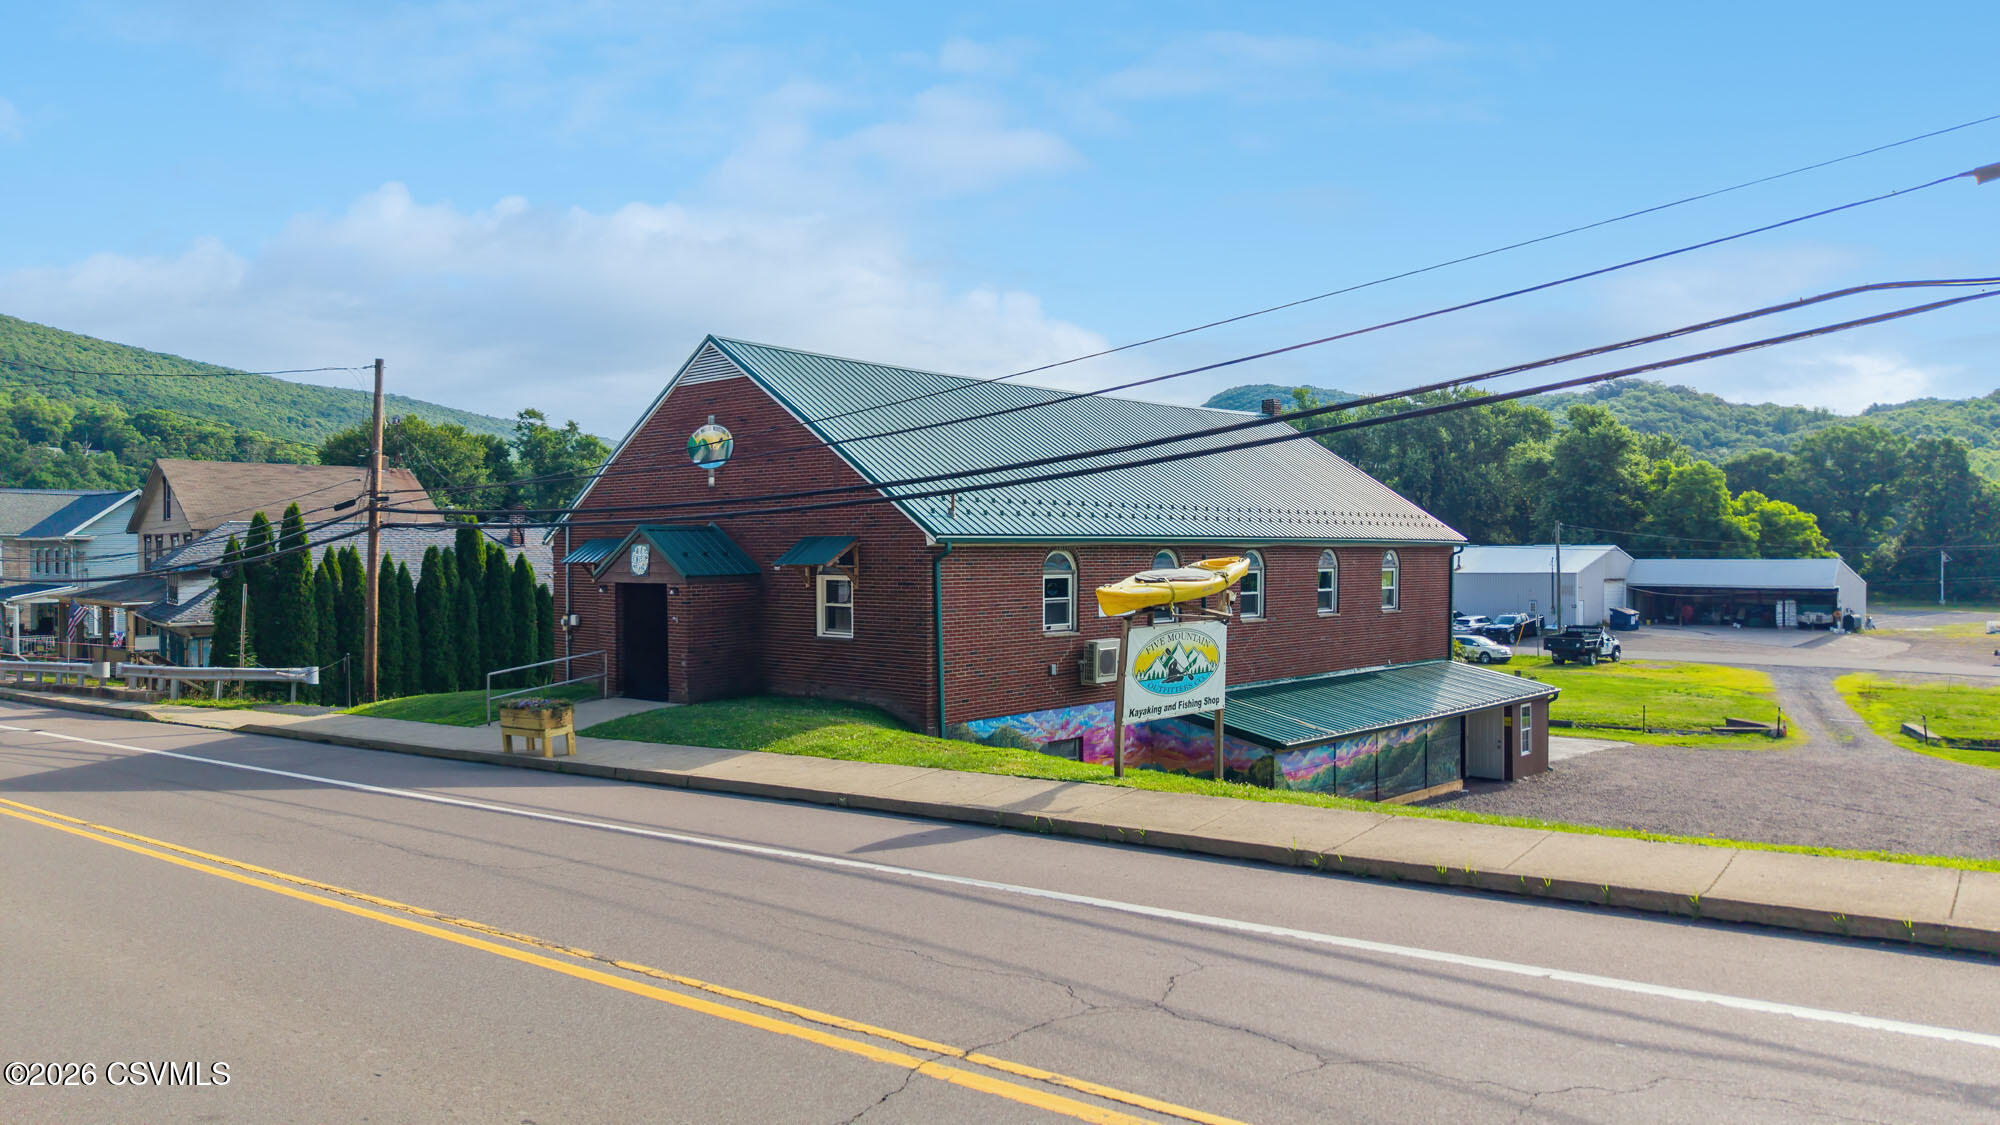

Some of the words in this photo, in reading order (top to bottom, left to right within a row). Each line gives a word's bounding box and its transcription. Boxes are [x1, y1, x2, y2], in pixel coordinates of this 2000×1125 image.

[1145, 637, 1166, 655] FIVE
[1167, 632, 1211, 648] MOUNTAIN
[1147, 682, 1193, 693] OUTFITTERS
[1128, 706, 1162, 718] Kayaking
[1163, 702, 1177, 710] and
[1178, 699, 1202, 710] Fishing
[1203, 697, 1220, 706] Shop
